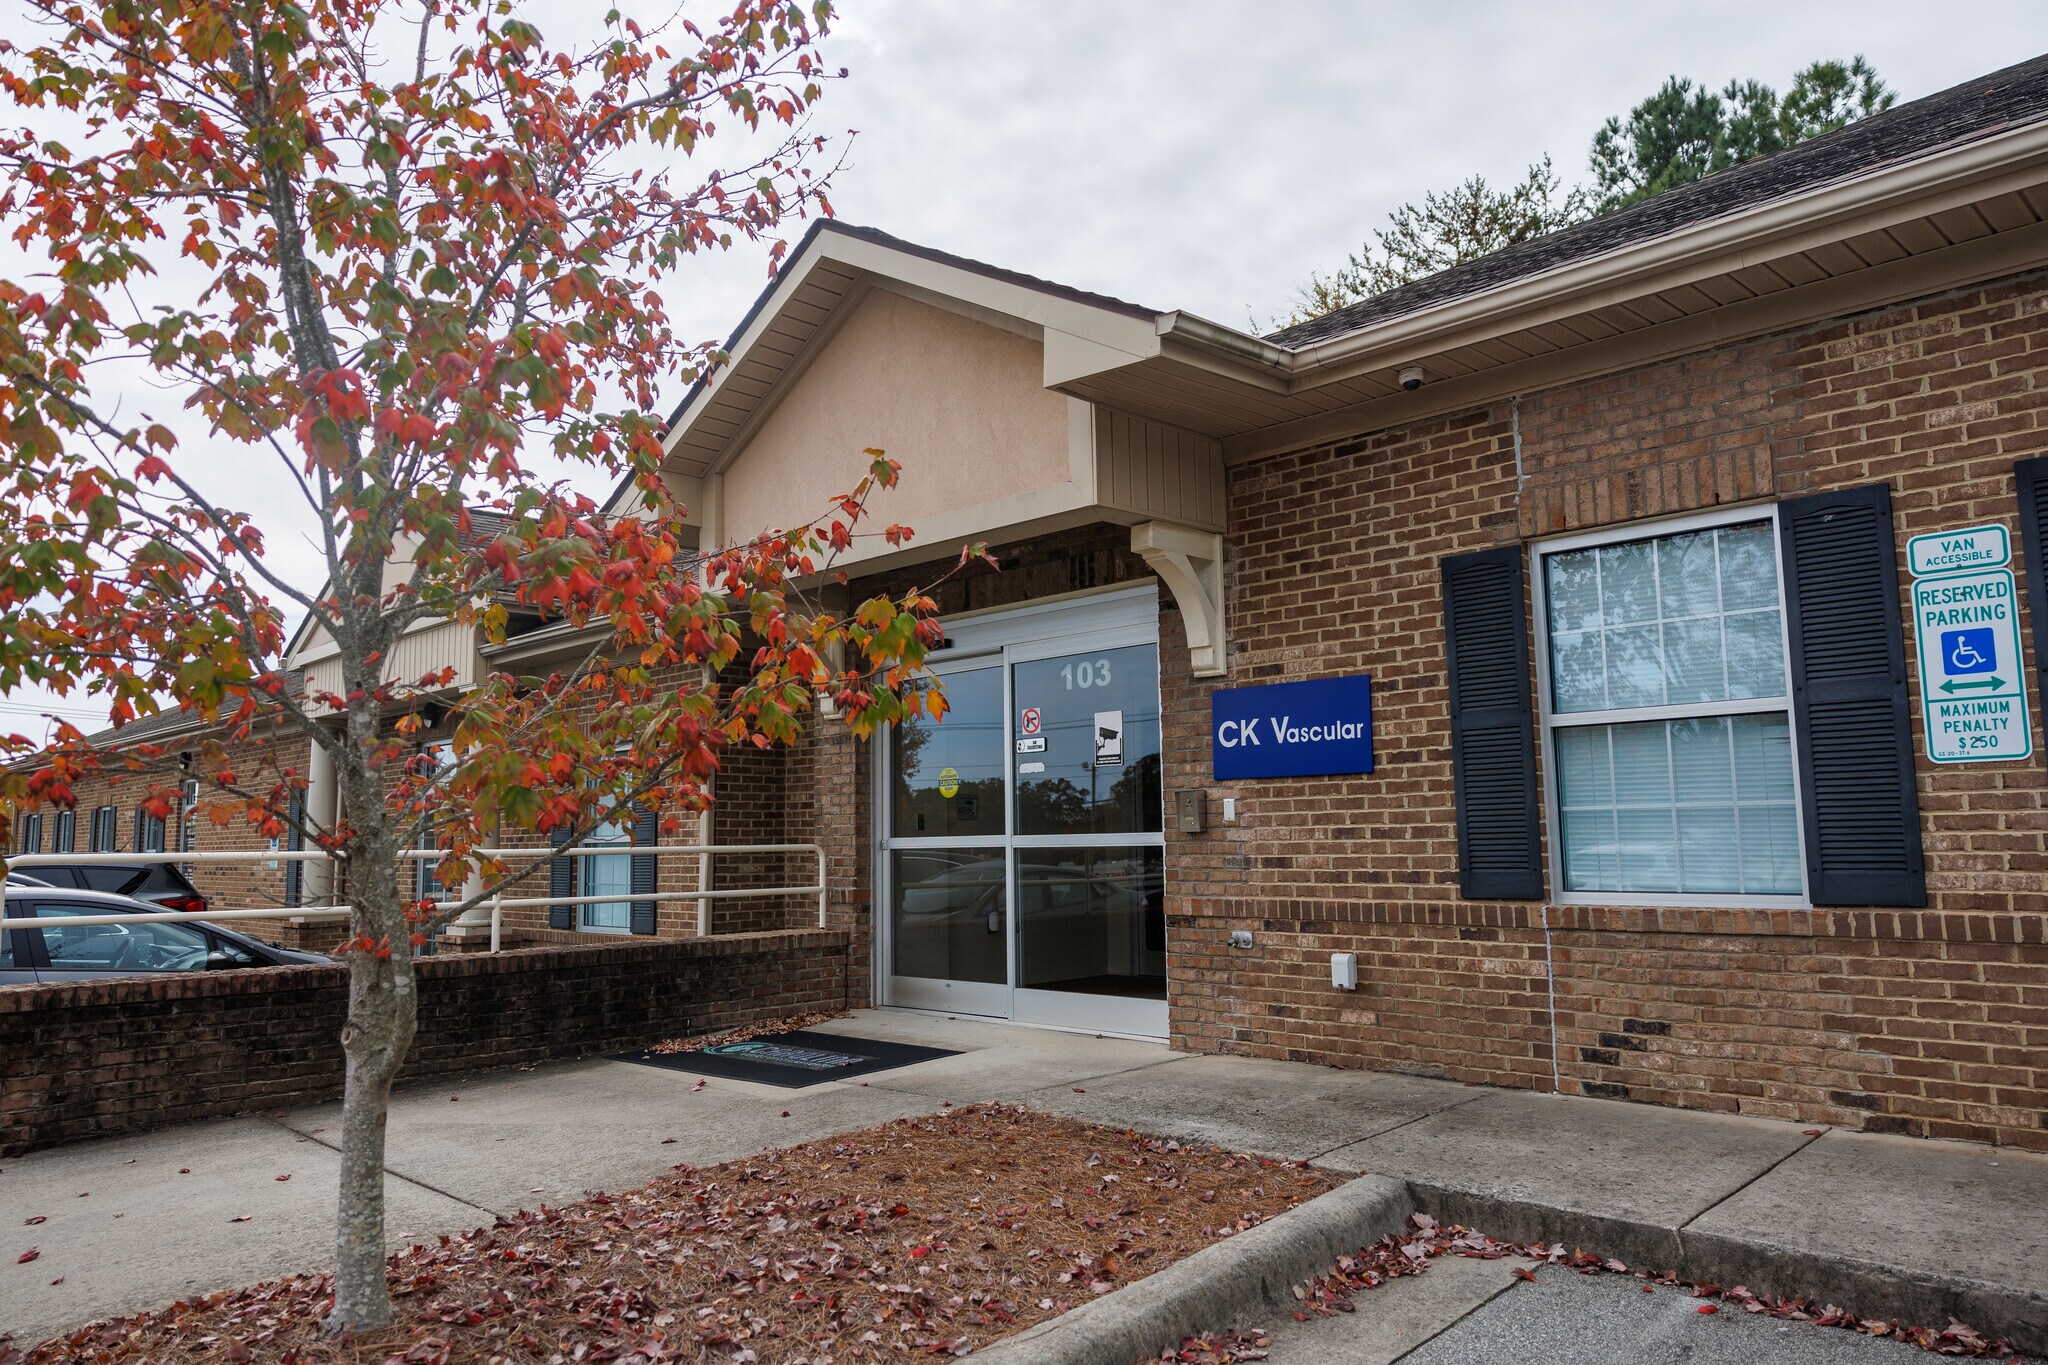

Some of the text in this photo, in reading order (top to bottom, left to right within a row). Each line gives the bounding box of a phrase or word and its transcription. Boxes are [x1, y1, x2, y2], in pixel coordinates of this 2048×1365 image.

[1941, 537, 1975, 553] VAN
[1926, 550, 1993, 566] ACCESSIBLE
[1920, 581, 2008, 607] RESERVED
[1926, 603, 2006, 627] PARKING
[1060, 659, 1112, 690] 103
[1940, 701, 2010, 717] MAXIMUM
[1218, 716, 1364, 748] CK Vascular
[1944, 718, 2009, 733] PENALTY
